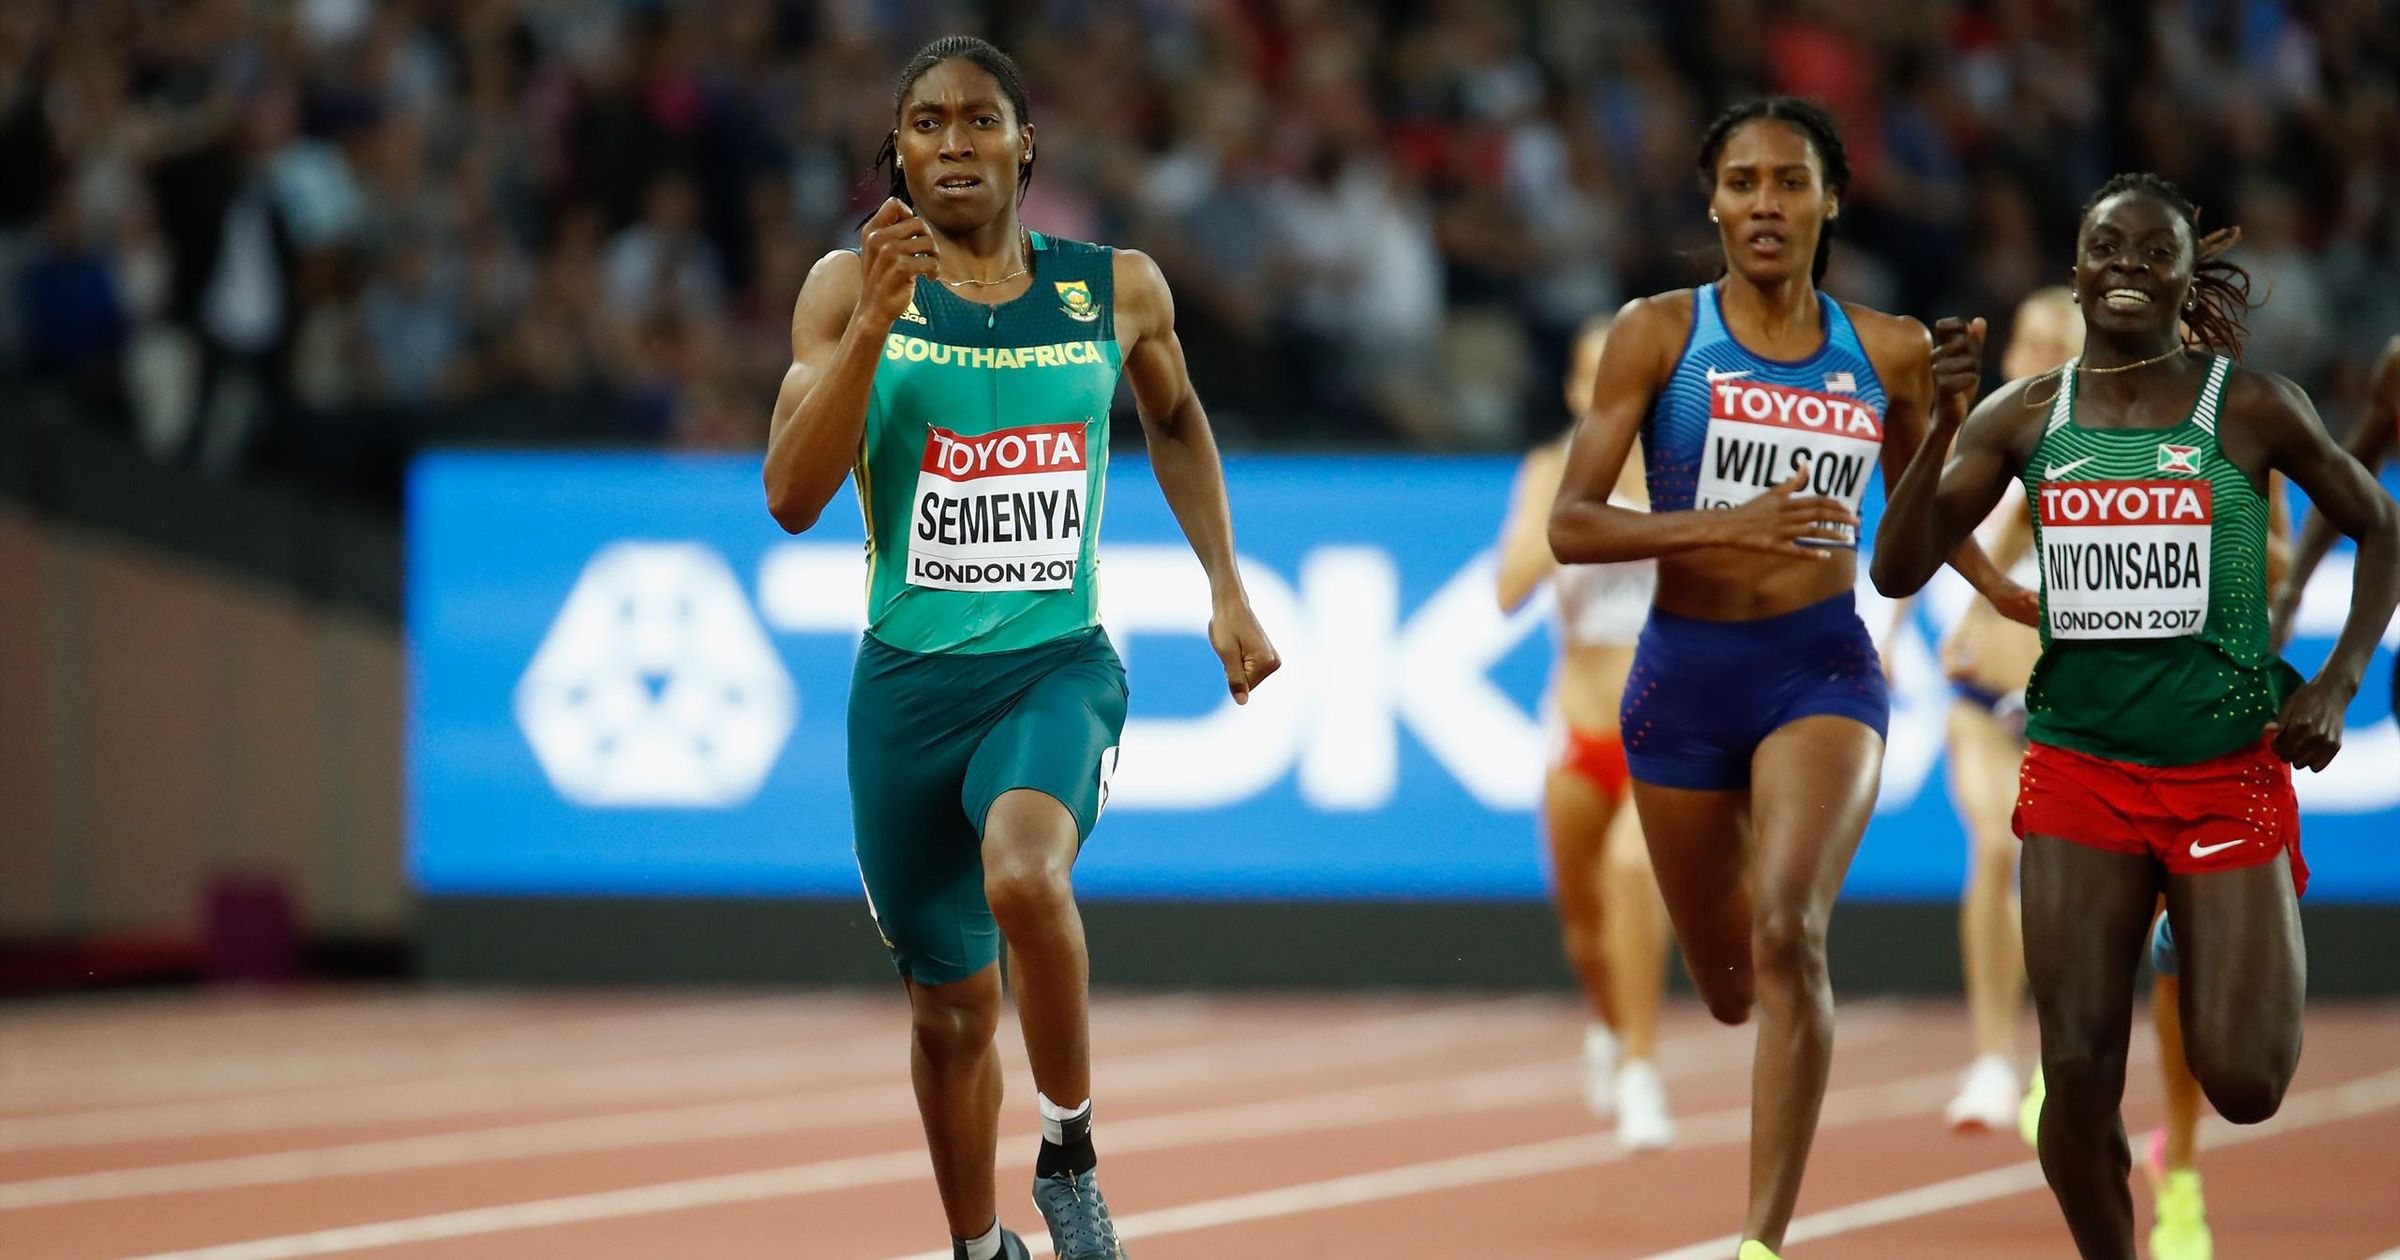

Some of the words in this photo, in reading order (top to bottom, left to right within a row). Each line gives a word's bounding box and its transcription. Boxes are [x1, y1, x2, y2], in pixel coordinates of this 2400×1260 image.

[1717, 384, 1876, 436] TOYOTA
[935, 432, 1080, 475] TOYOTA
[1716, 438, 1863, 497] WILSON
[917, 489, 1081, 545] SEMENYA
[2042, 486, 2204, 520] TOYOTA
[914, 558, 1026, 584] LONDON
[1031, 560, 1077, 581] 201
[2049, 542, 2201, 590] NIYONSABA
[2053, 611, 2143, 630] LONDON
[2148, 609, 2202, 630] 2017
